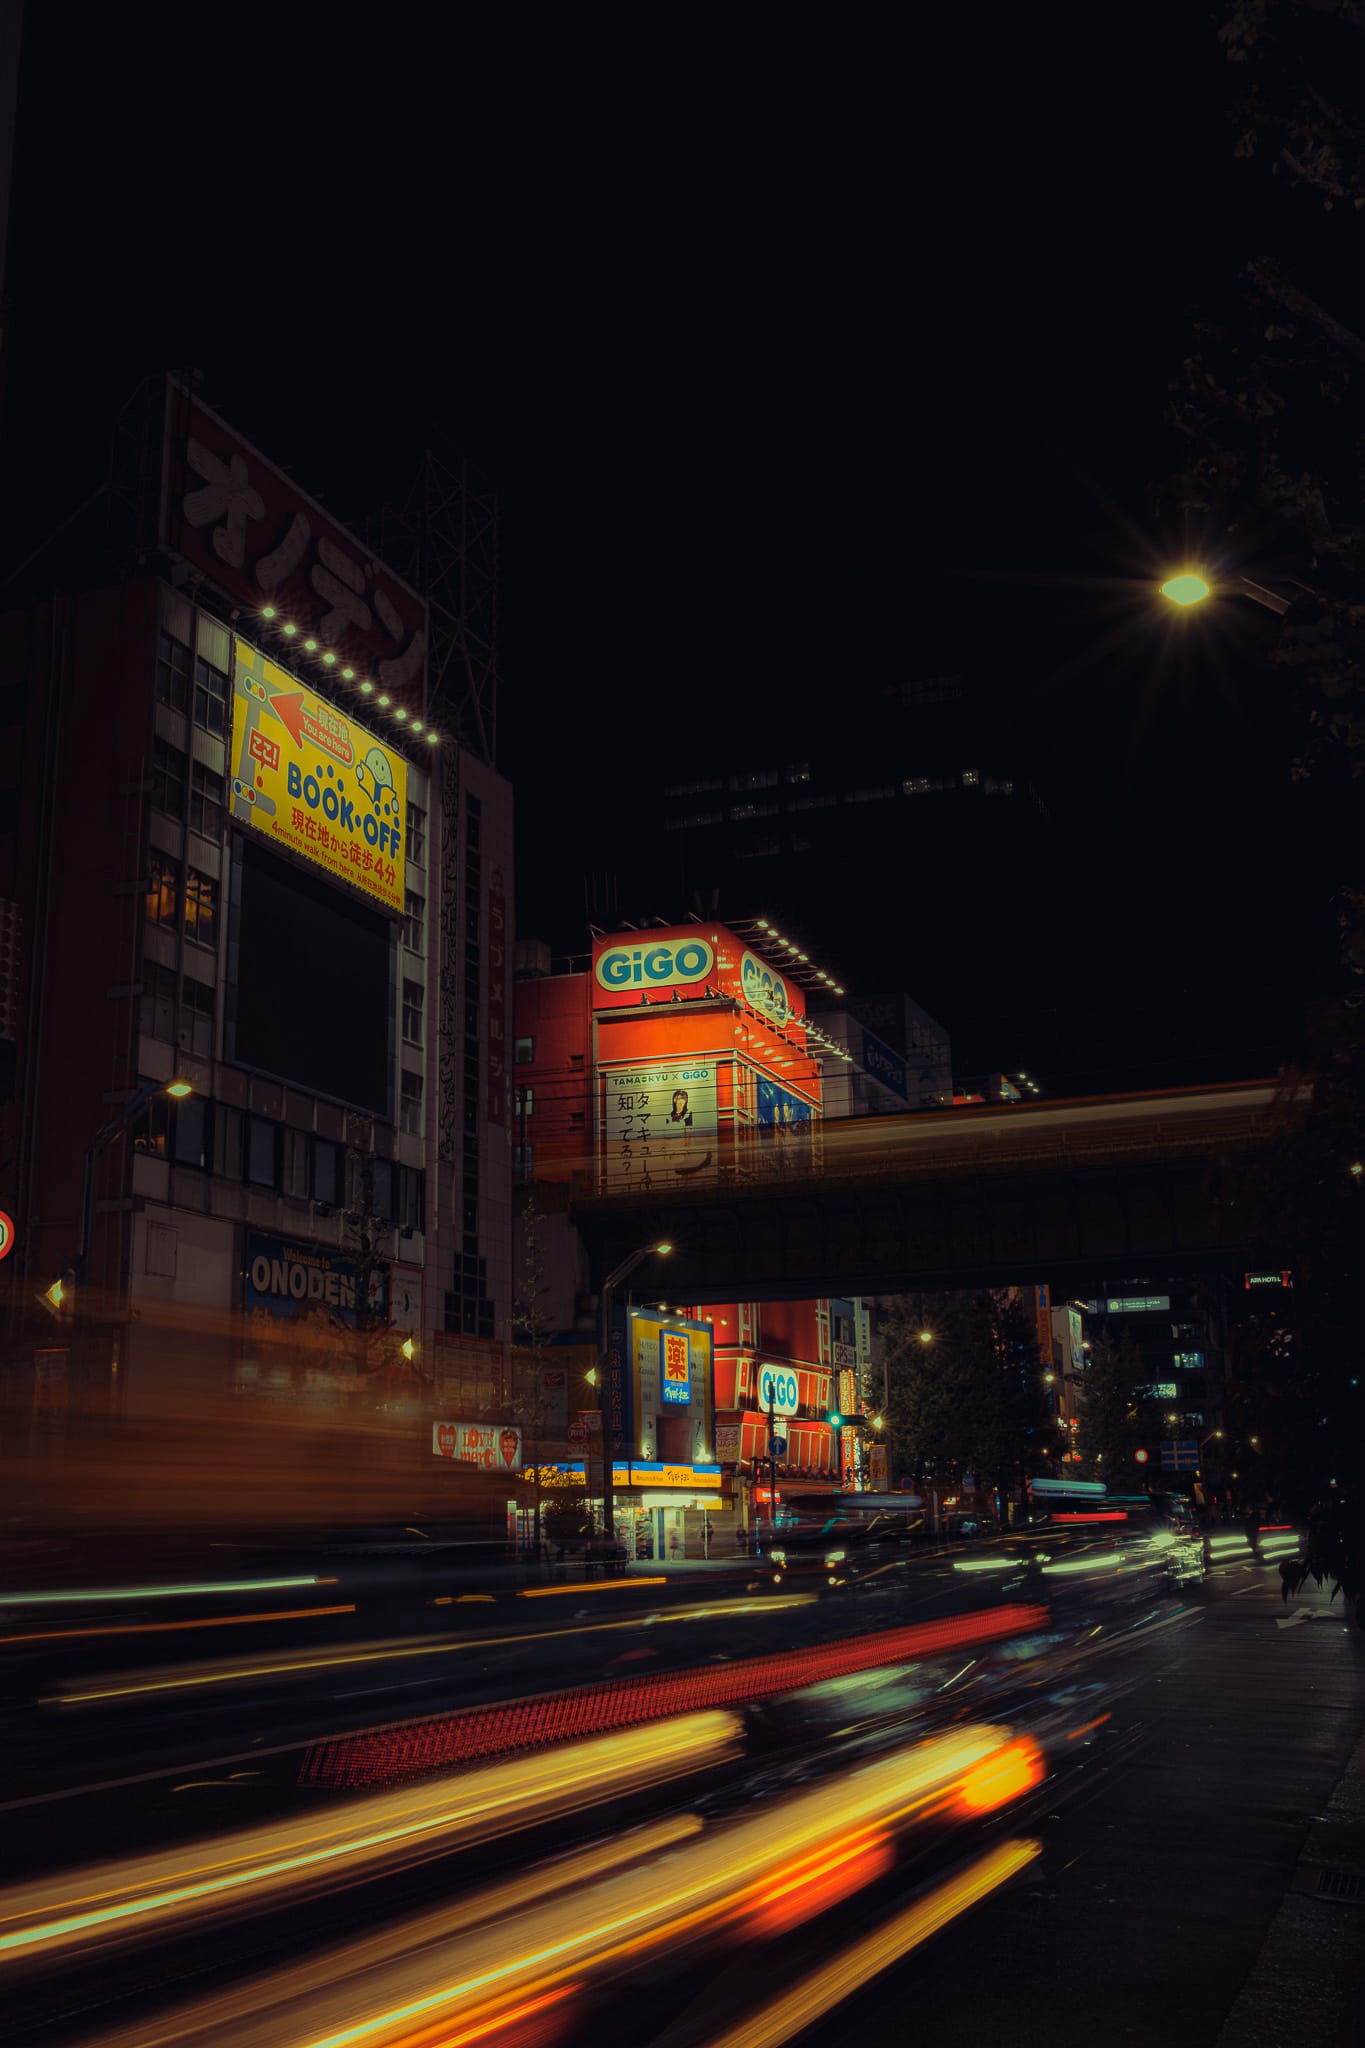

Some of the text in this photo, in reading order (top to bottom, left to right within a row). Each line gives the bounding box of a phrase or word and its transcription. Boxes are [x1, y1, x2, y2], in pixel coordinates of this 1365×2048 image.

[184, 436, 425, 687] オノデン
[303, 716, 351, 759] You are here
[318, 706, 349, 745] 現在地
[291, 806, 397, 887] 現在地から徒歩4分
[303, 843, 320, 858] walk
[321, 850, 338, 869] from
[339, 861, 354, 878] here
[602, 944, 708, 985] GiGO
[682, 1070, 709, 1080] GiGO
[283, 1247, 320, 1268] Welcome
[252, 1256, 357, 1310] ONODEN
[667, 1337, 687, 1380] 薬
[835, 1343, 848, 1363] GPS
